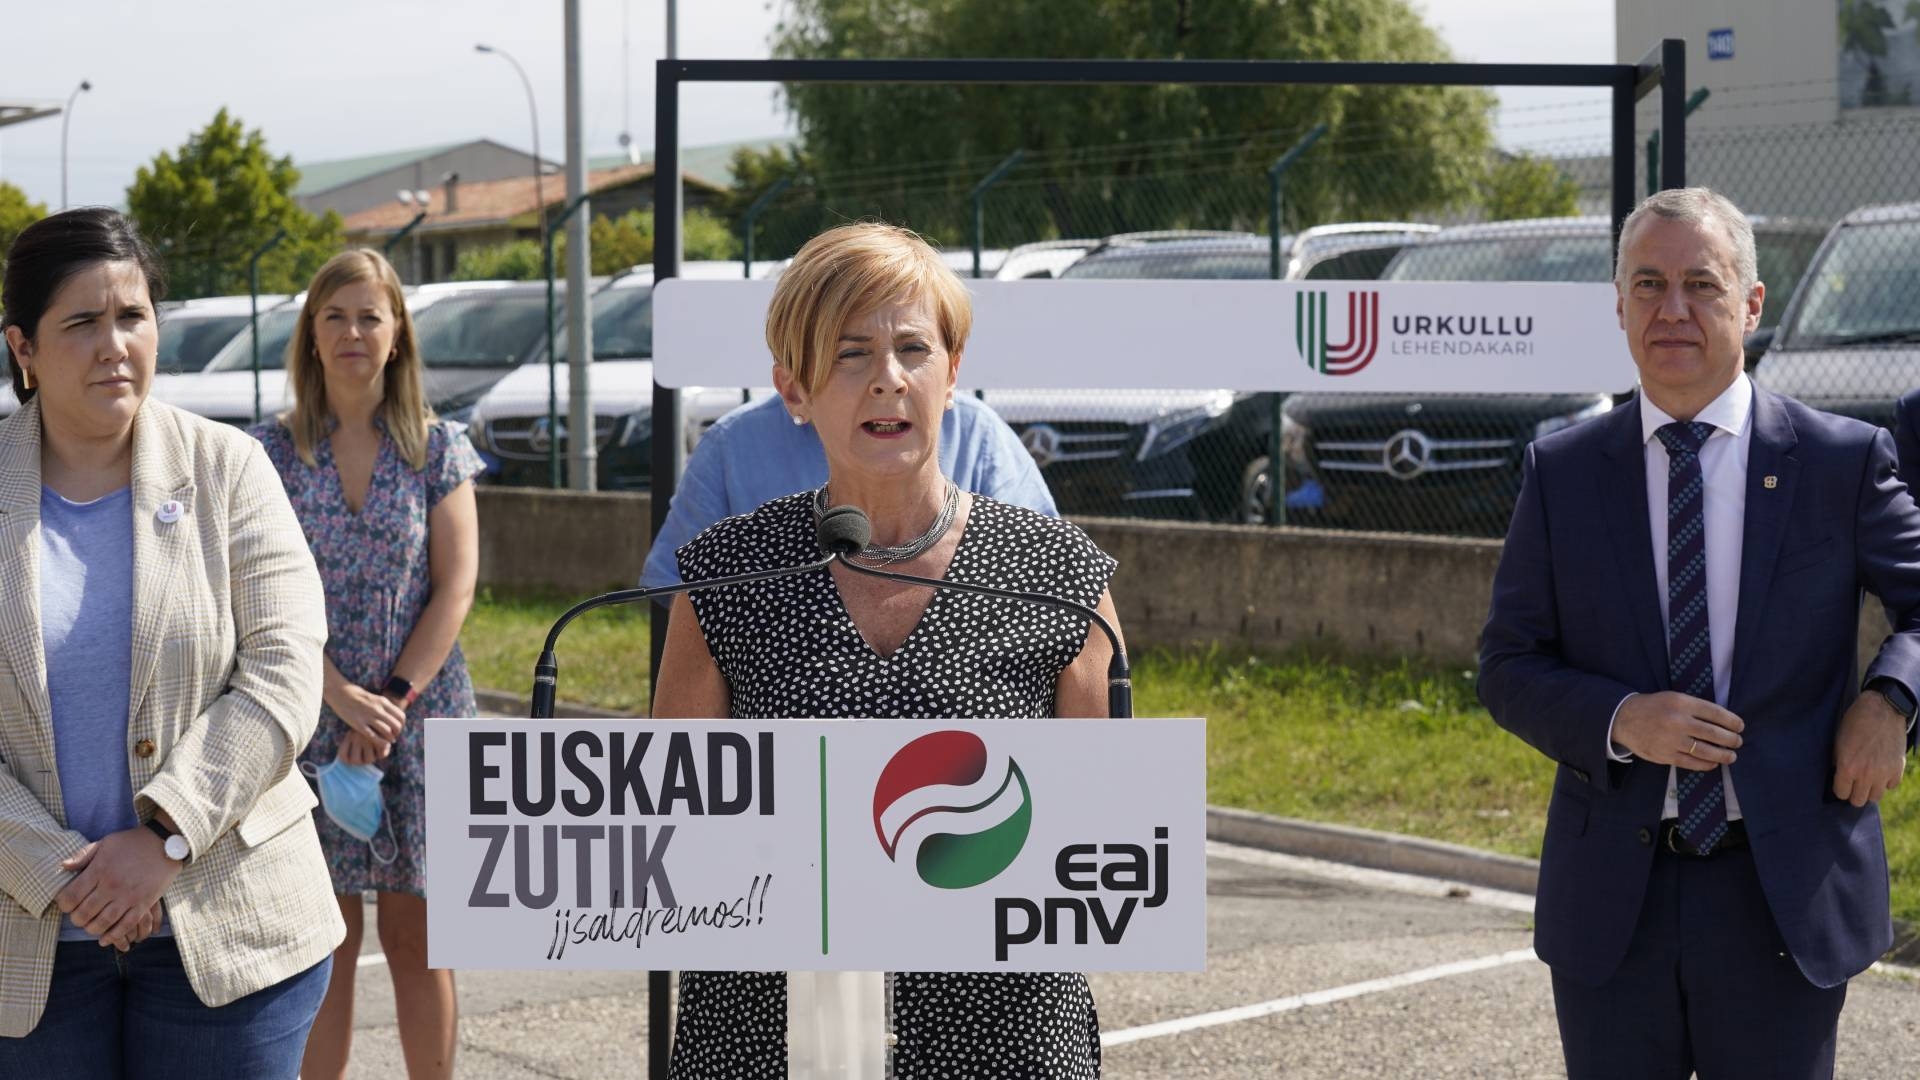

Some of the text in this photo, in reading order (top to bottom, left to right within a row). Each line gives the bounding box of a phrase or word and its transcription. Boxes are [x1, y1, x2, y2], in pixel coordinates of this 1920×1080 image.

[1391, 340, 1535, 356] LEHENDAKARI
[1392, 315, 1534, 336] URKULLU
[468, 730, 775, 818] EUSKADI
[467, 824, 678, 910] ZUTIK
[1054, 826, 1169, 908] eaj
[994, 896, 1139, 962] pnv
